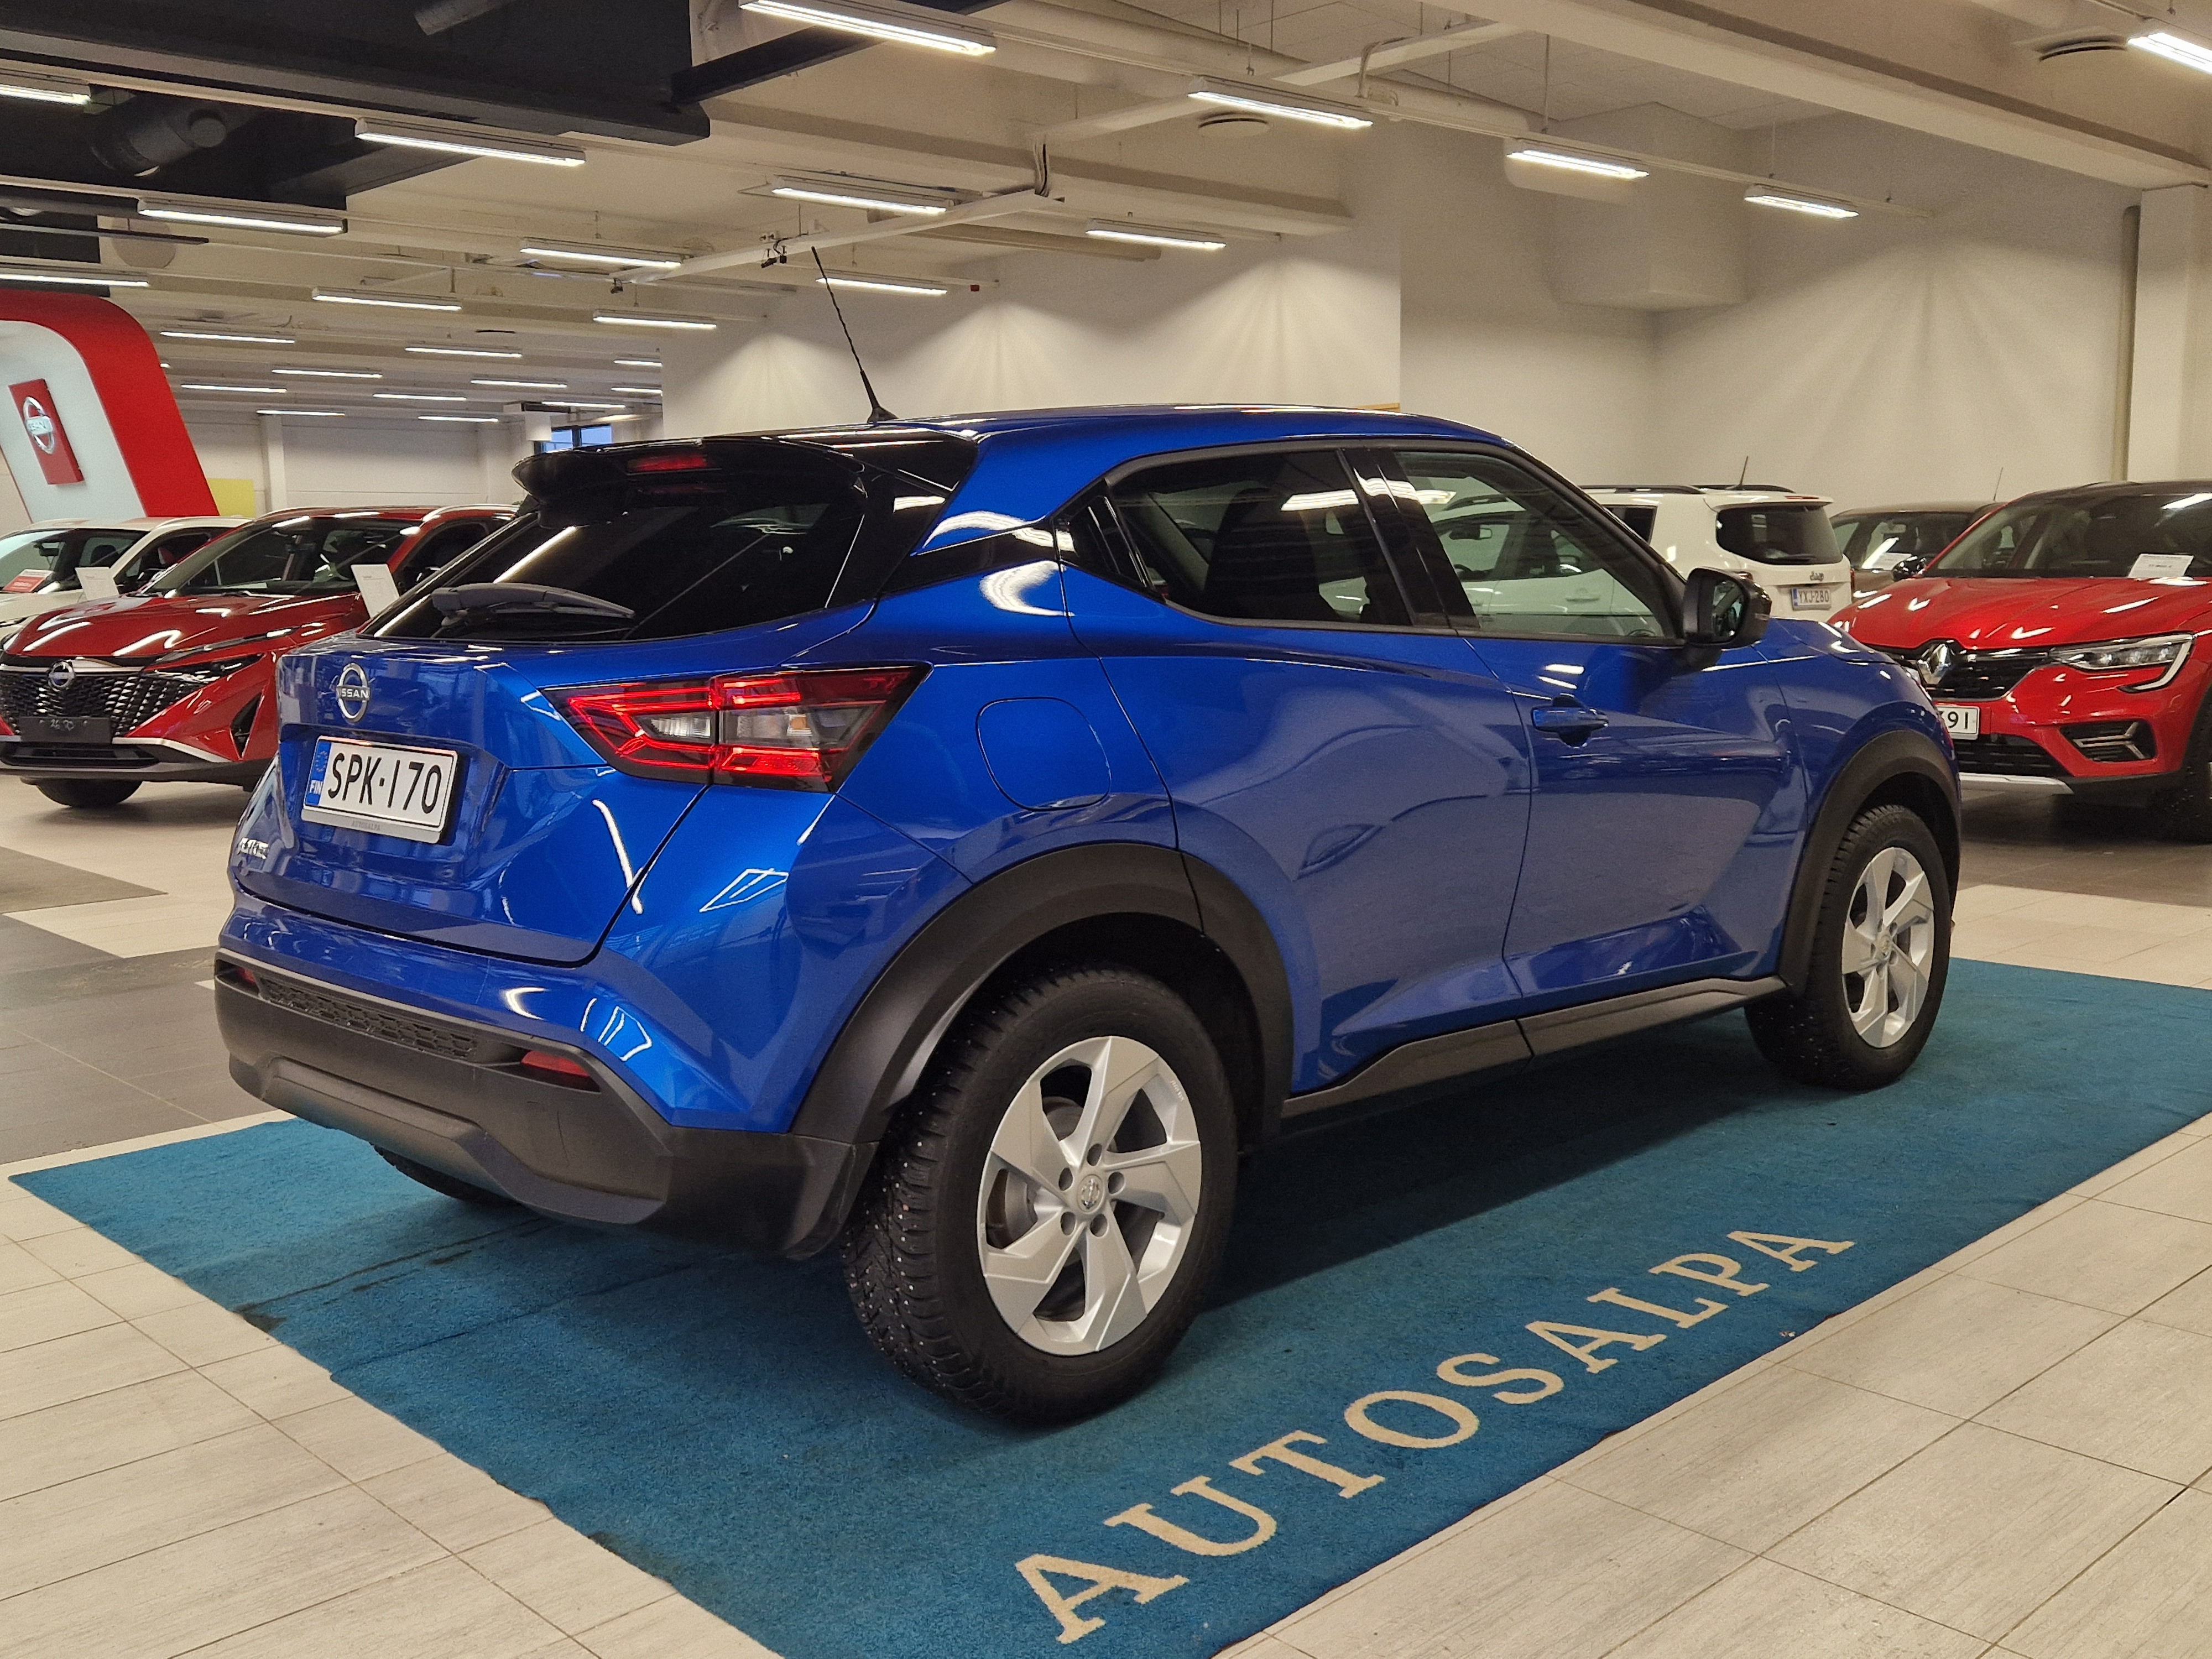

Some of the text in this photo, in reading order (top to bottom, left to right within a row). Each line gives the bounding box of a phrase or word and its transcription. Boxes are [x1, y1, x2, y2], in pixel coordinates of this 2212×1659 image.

[337, 688, 369, 698] SSAN
[309, 780, 323, 795] FIN
[328, 753, 441, 814] SPK-170
[1014, 1230, 1855, 1644] AUTOSALPA
